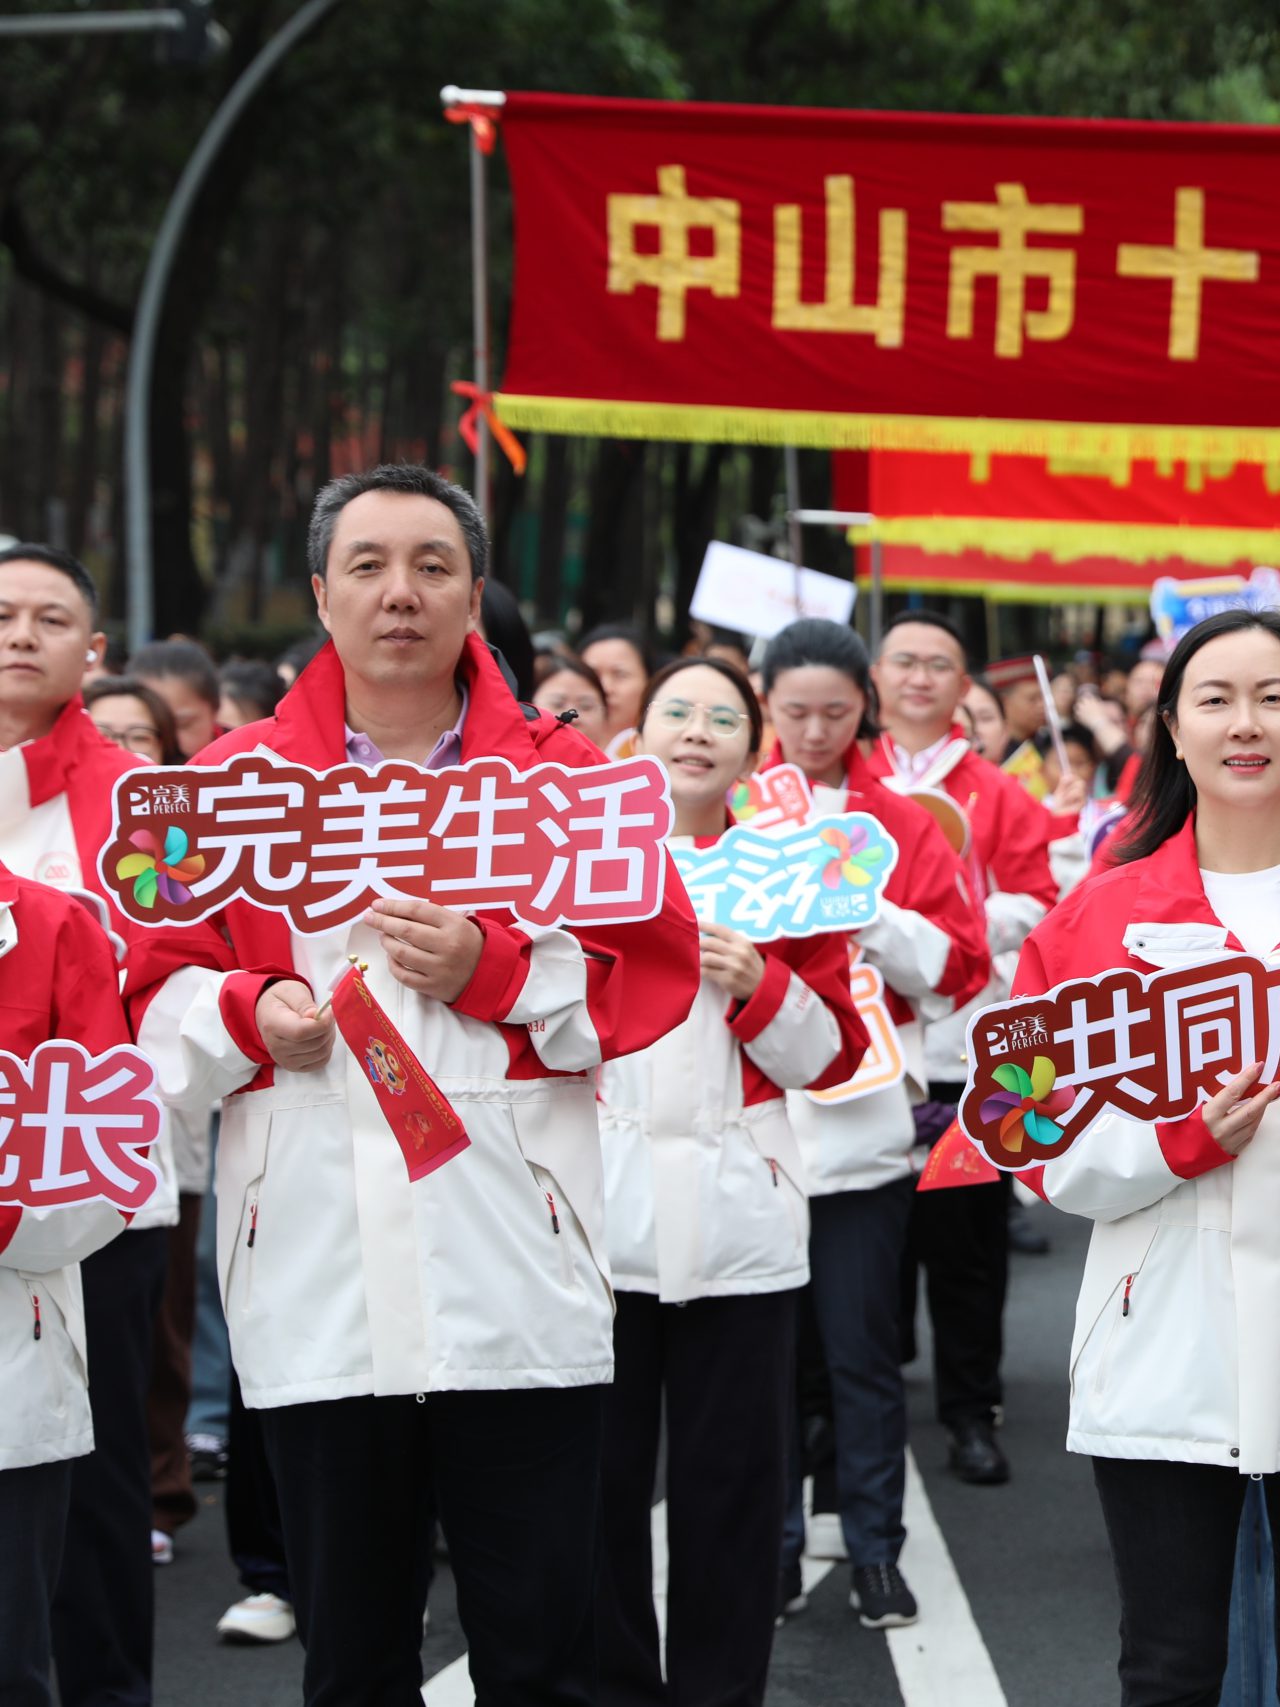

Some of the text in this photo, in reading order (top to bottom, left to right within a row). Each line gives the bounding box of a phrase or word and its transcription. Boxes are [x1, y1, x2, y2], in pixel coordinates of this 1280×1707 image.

[152, 784, 190, 804] 完美
[153, 803, 191, 814] PERFECT
[188, 771, 654, 919] 完美生活
[1009, 1014, 1047, 1040] 完美
[1011, 1033, 1048, 1050] PERFECT
[0, 1062, 144, 1194] 长
